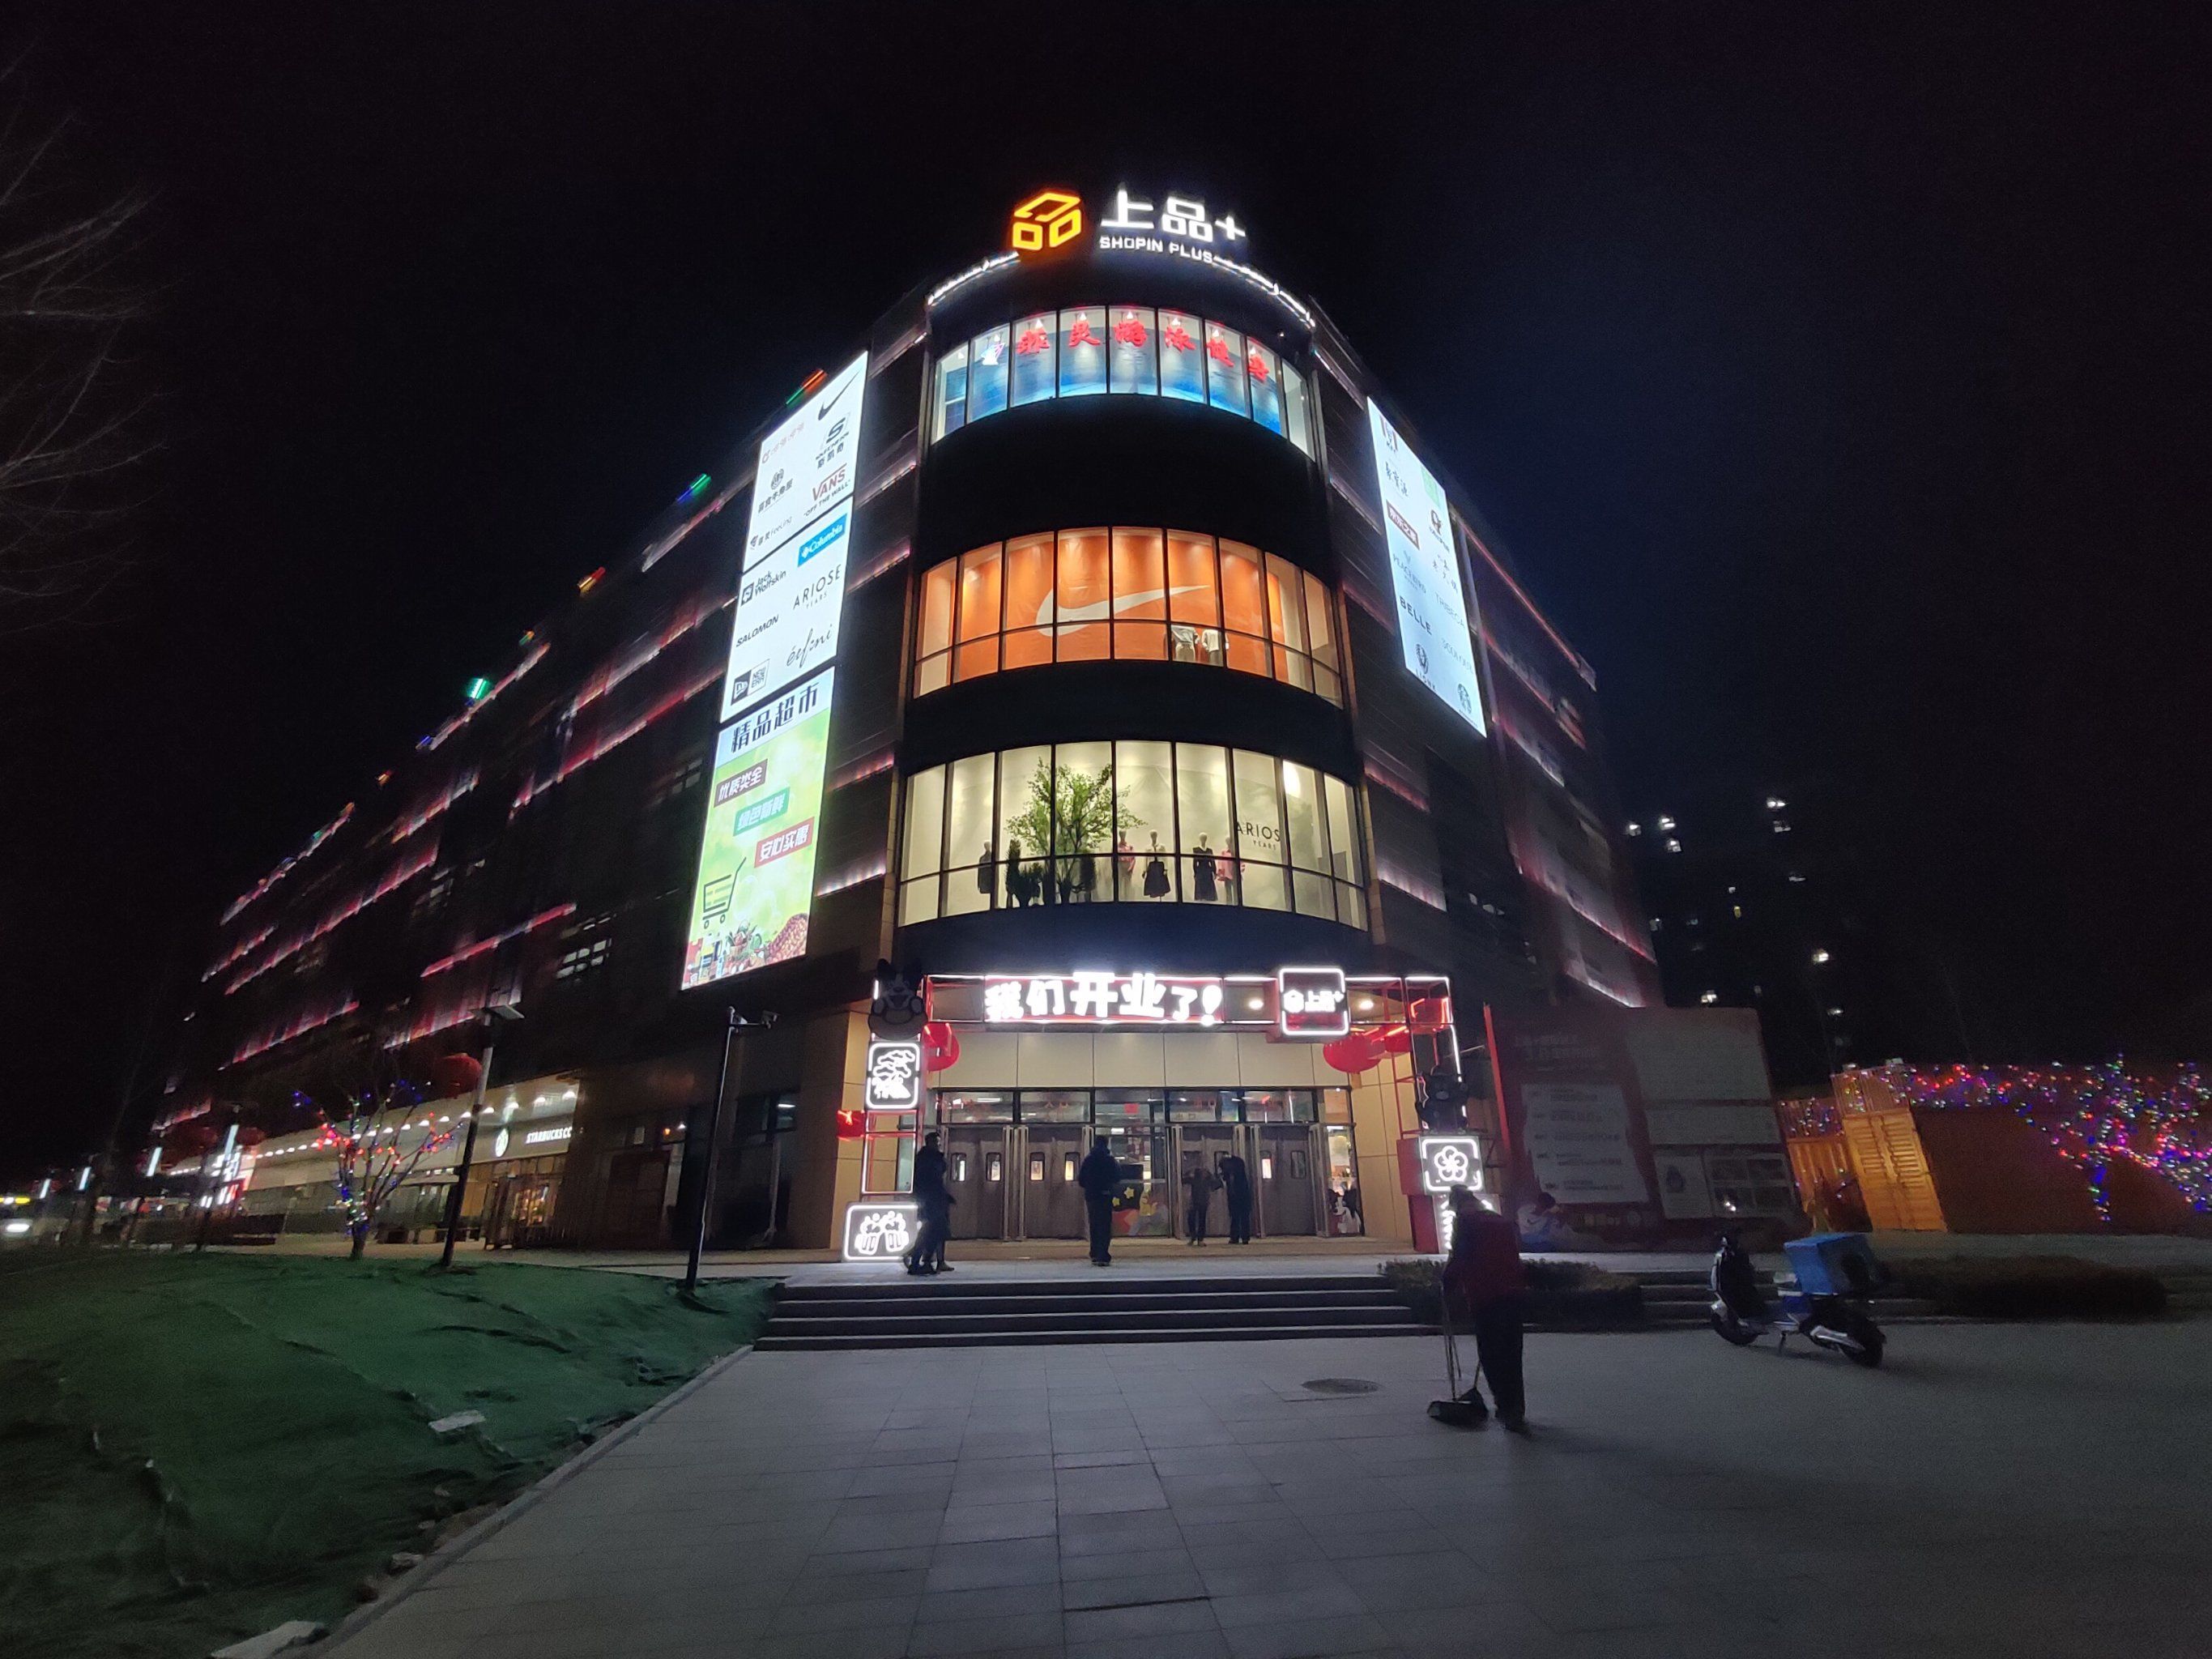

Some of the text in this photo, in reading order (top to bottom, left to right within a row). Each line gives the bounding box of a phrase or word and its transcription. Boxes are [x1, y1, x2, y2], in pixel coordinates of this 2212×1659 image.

[1100, 235, 1214, 265] SHOPIN PLUS
[812, 463, 847, 501] VANS
[810, 523, 842, 552] Columbia
[755, 570, 786, 596] Wolfskin
[756, 569, 772, 587] Jack
[793, 564, 842, 609] ARIOSE
[736, 614, 779, 647] SALOMON
[1400, 595, 1431, 635] BELLE
[731, 681, 819, 753] 精品超市
[760, 824, 809, 862] 安心实惠
[1252, 840, 1277, 851] YEARS
[526, 1128, 563, 1144] STARBUCKS
